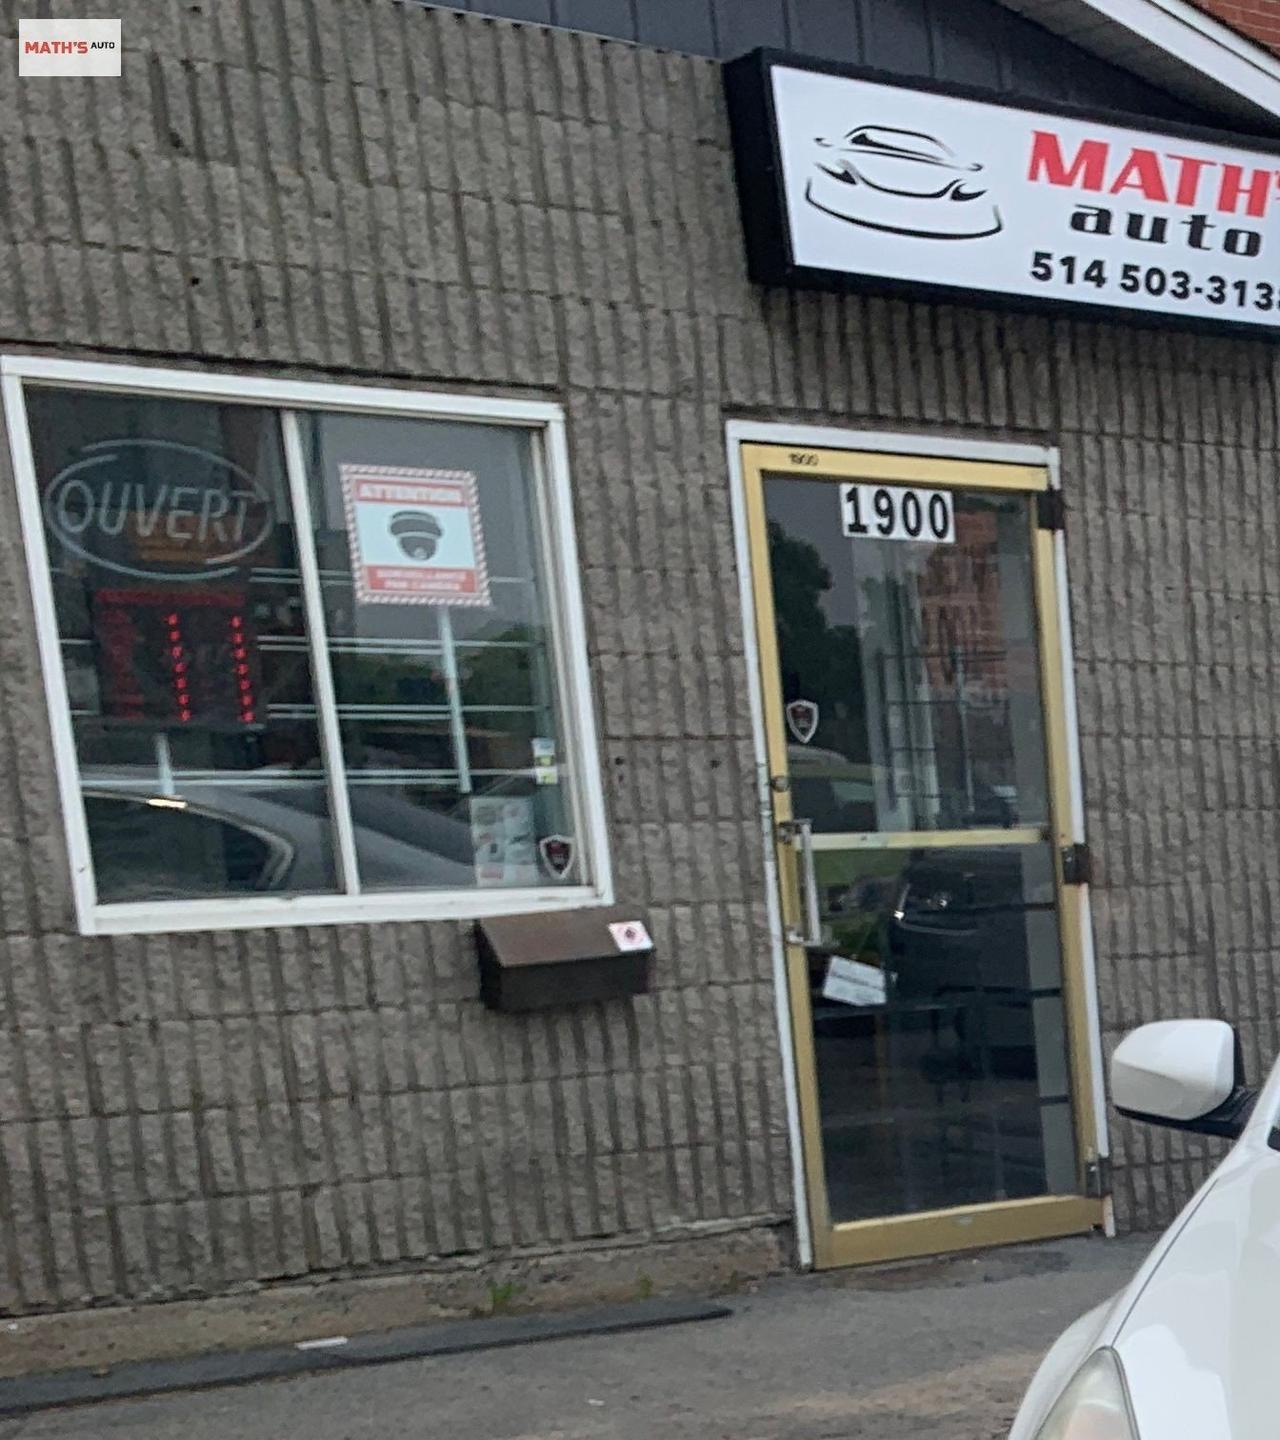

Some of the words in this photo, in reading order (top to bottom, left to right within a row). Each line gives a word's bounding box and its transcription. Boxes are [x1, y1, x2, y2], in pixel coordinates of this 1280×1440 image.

[1069, 203, 1262, 257] auto
[1031, 251, 1107, 288] 514
[57, 479, 256, 543] OUVERT
[846, 487, 949, 539] 1900
